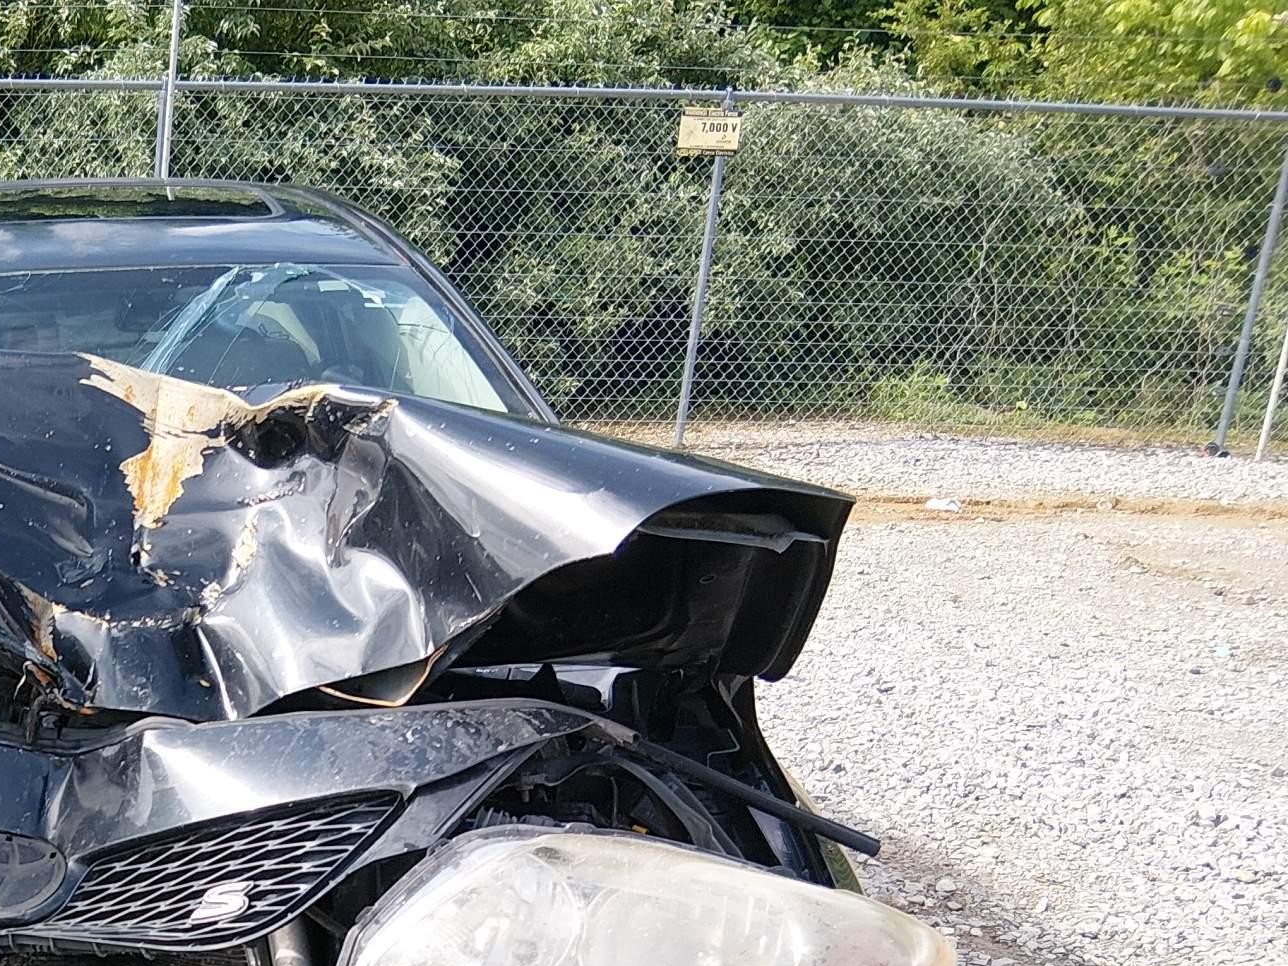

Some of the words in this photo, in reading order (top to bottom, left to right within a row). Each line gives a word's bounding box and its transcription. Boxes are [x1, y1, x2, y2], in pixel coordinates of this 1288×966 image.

[701, 122, 729, 134] 7,000
[731, 122, 738, 133] V
[189, 881, 254, 925] S
